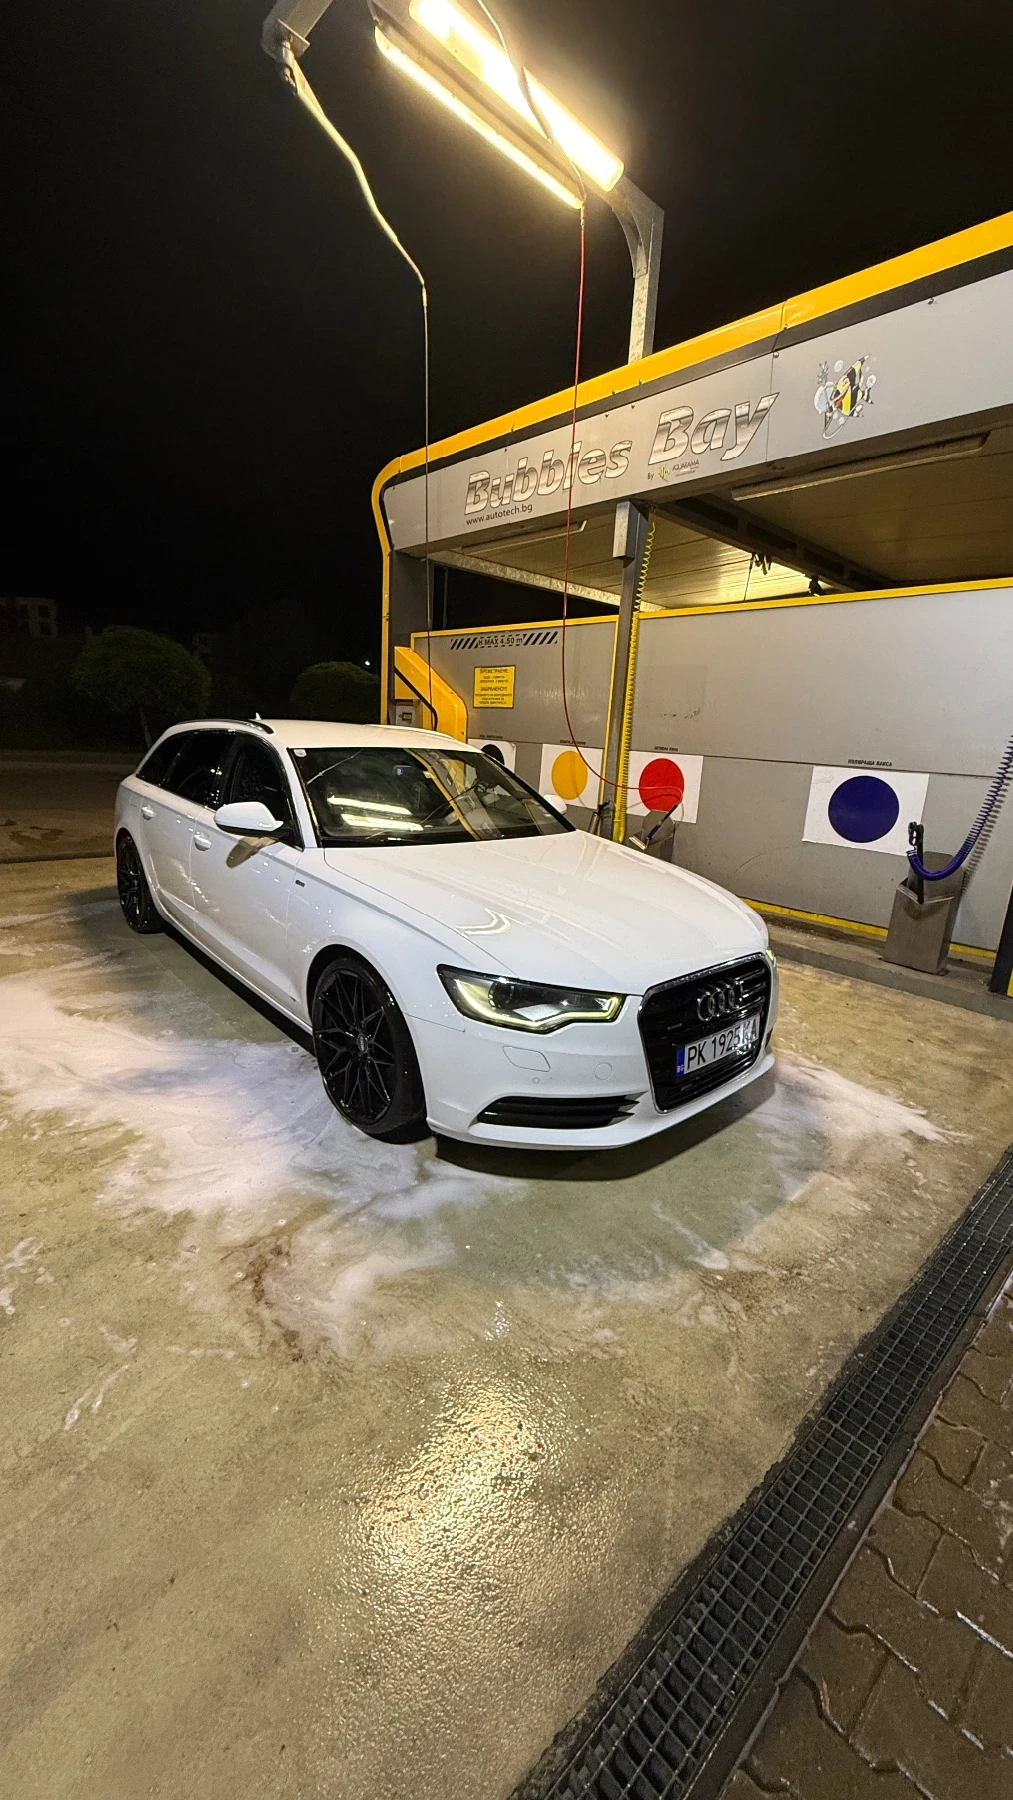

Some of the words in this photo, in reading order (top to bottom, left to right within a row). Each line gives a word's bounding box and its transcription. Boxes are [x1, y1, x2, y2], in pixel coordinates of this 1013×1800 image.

[463, 440, 633, 516] Bubbles
[647, 391, 780, 466] Bay
[466, 503, 533, 525] www.autotech.bg
[500, 637, 515, 645] 4.50
[687, 1040, 707, 1069] PK
